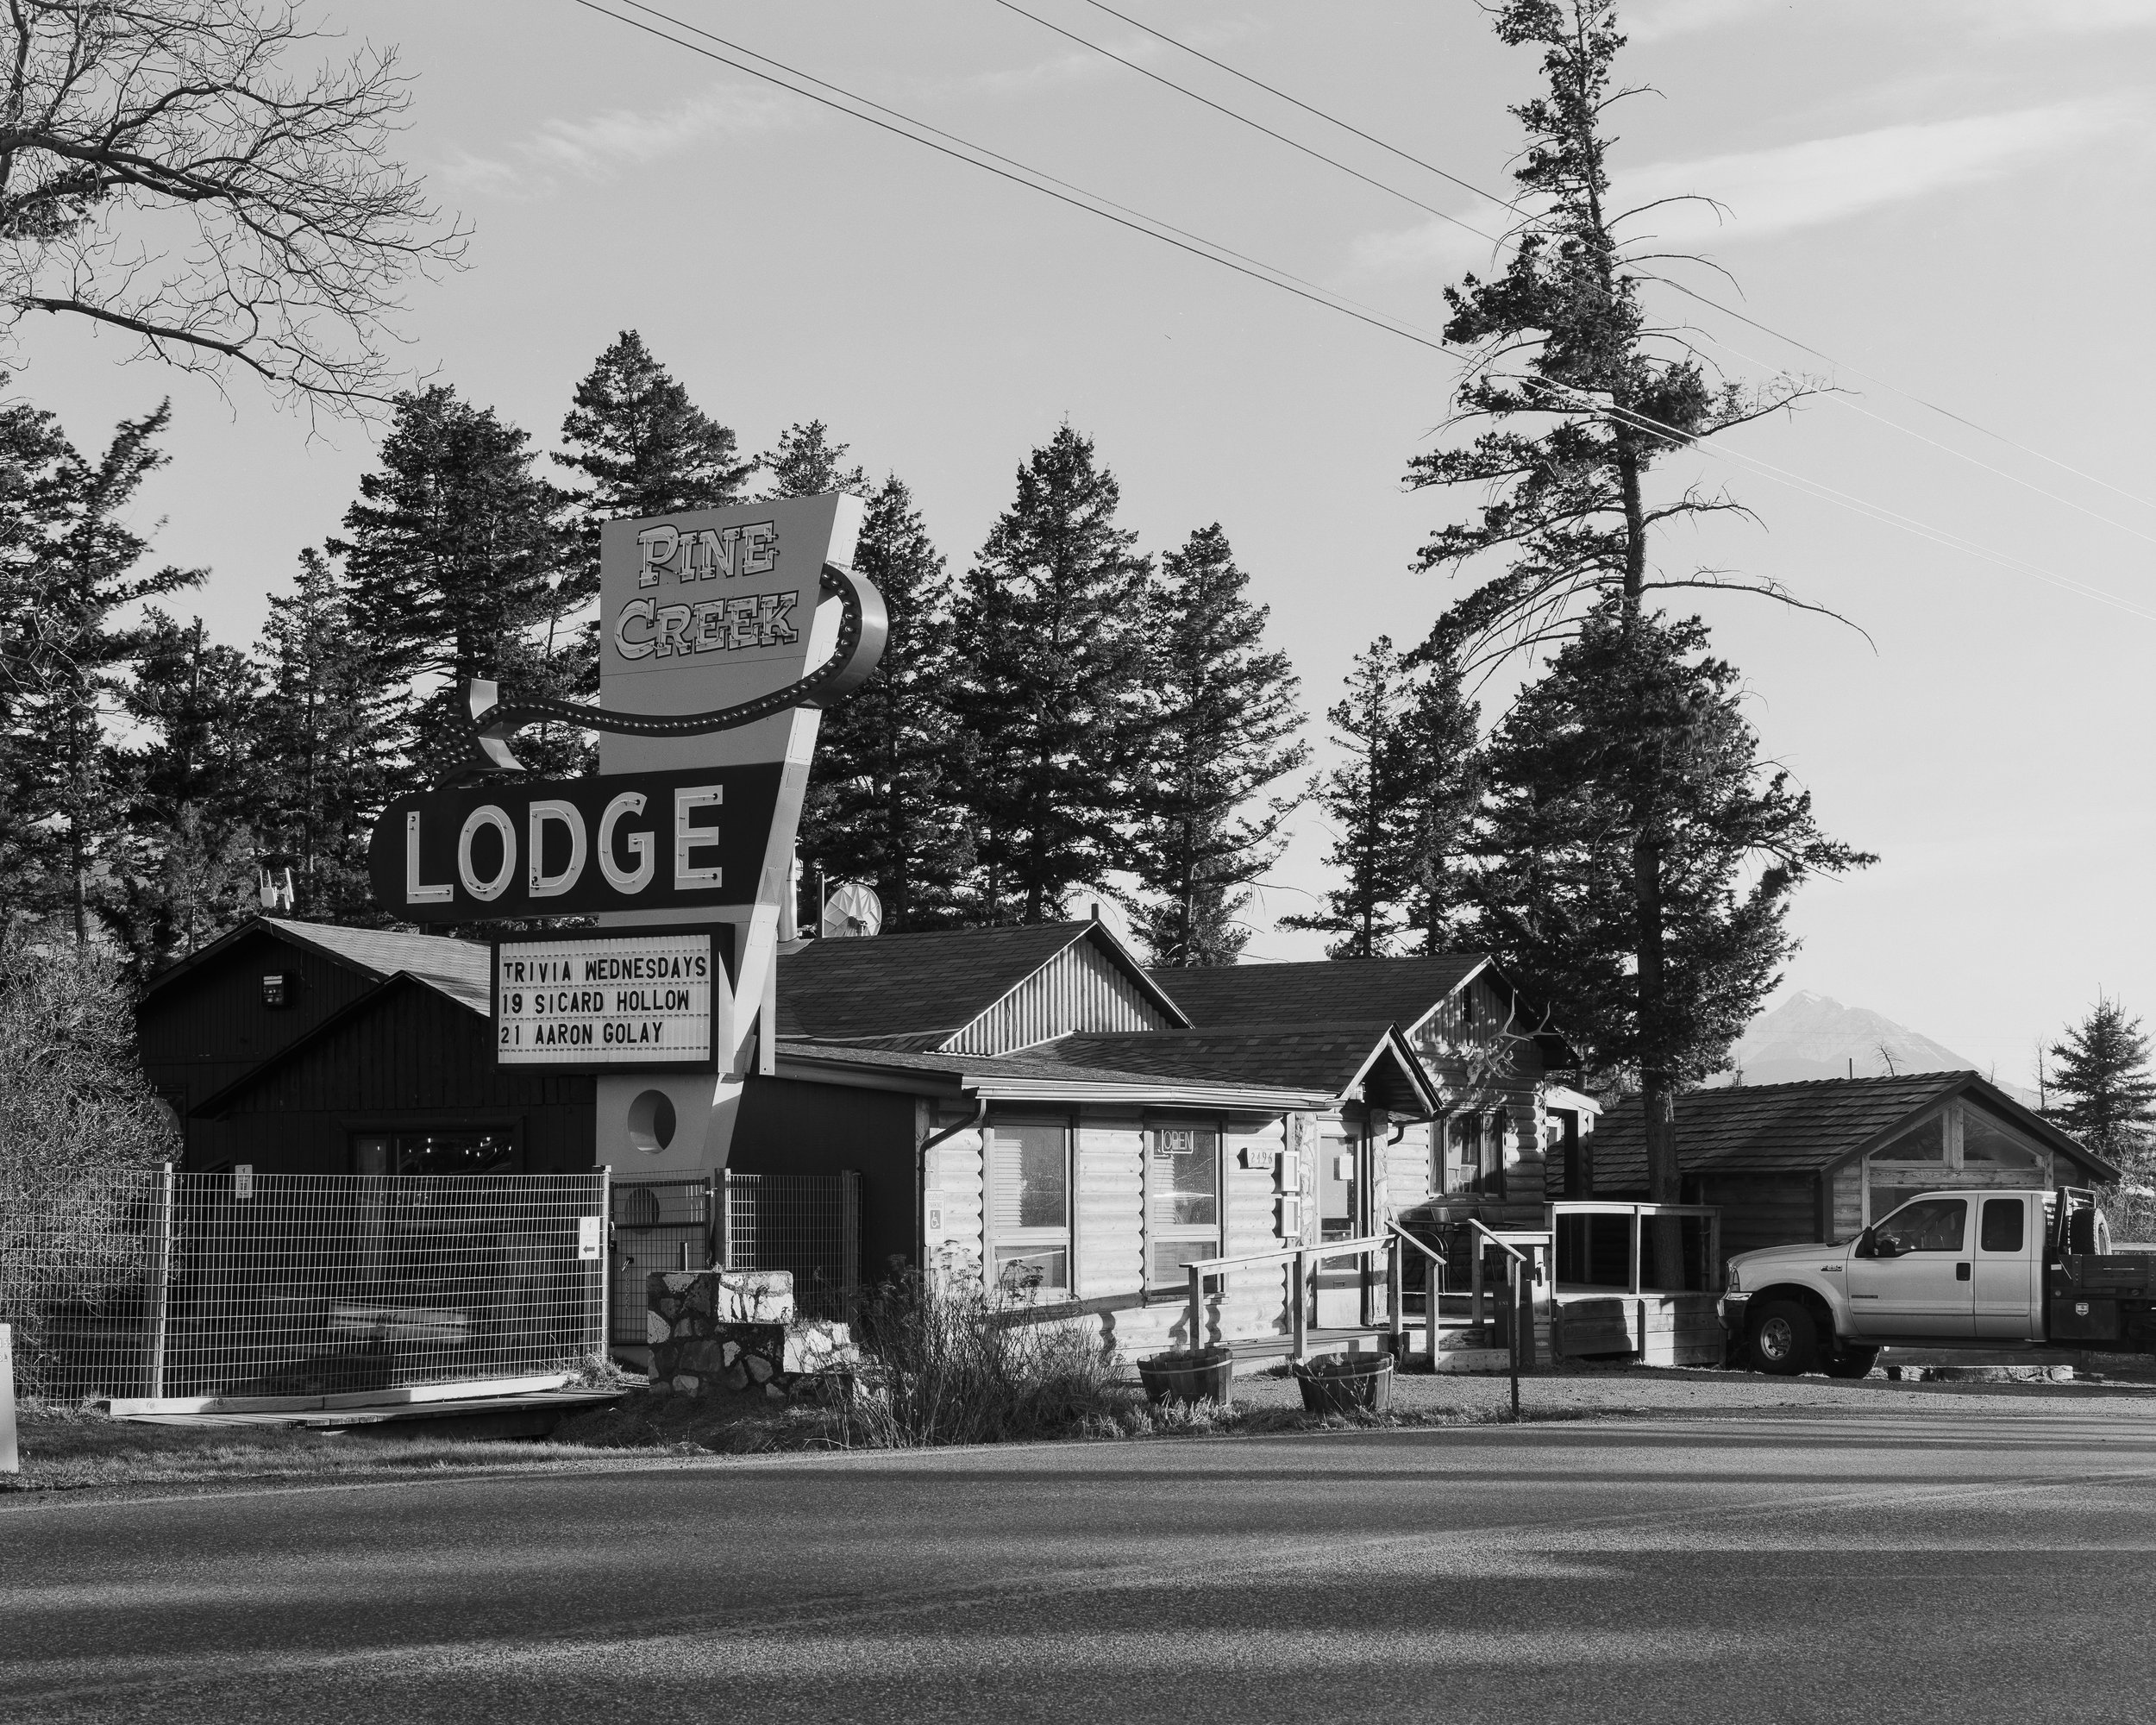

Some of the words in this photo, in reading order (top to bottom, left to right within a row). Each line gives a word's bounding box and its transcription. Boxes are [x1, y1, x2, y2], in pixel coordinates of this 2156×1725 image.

[636, 520, 774, 589] PINE
[613, 590, 799, 661] CREEK
[406, 784, 724, 904] LODGE
[503, 961, 572, 983] TRIVIA
[586, 956, 707, 982] WEDNESDAYS
[503, 993, 523, 1014] 19
[535, 992, 604, 1014] SICARD
[617, 989, 689, 1012] HOLLOW
[500, 1025, 520, 1044] 21
[535, 1023, 592, 1044] AARON
[603, 1021, 662, 1044] GOLAY
[1164, 1131, 1192, 1150] OPEN
